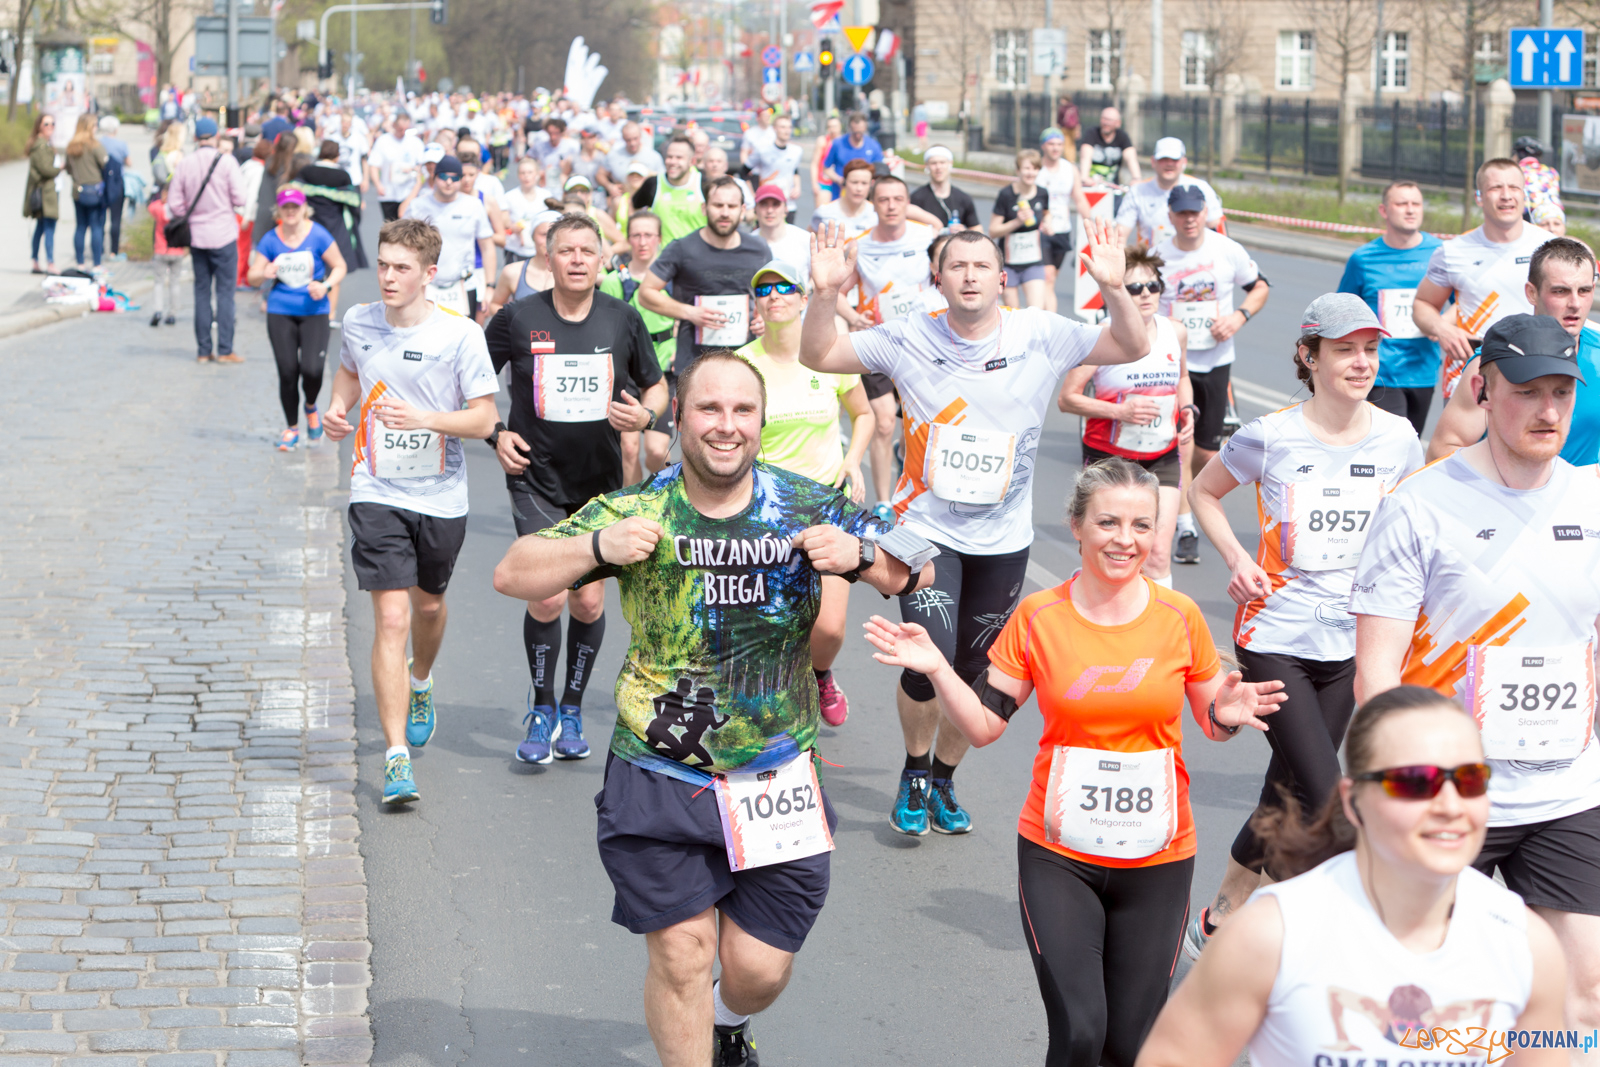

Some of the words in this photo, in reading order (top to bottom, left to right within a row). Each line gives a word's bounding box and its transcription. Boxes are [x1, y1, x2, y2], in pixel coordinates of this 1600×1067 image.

[530, 330, 555, 342] POL
[556, 376, 599, 393] 3715
[384, 433, 431, 450] 5457
[941, 449, 1005, 474] 10057
[1308, 510, 1371, 532] 8957
[674, 532, 793, 566] CHRZANÓW
[704, 572, 765, 606] BIEGA
[532, 643, 551, 688] Kalenji
[569, 642, 594, 691] Kalenji
[1500, 682, 1577, 711] 3892
[1518, 717, 1559, 726] Sławomir
[740, 784, 816, 821] 10652
[1079, 784, 1154, 813] 3188
[770, 819, 804, 832] Wojciech
[1089, 817, 1142, 828] Małgorzata
